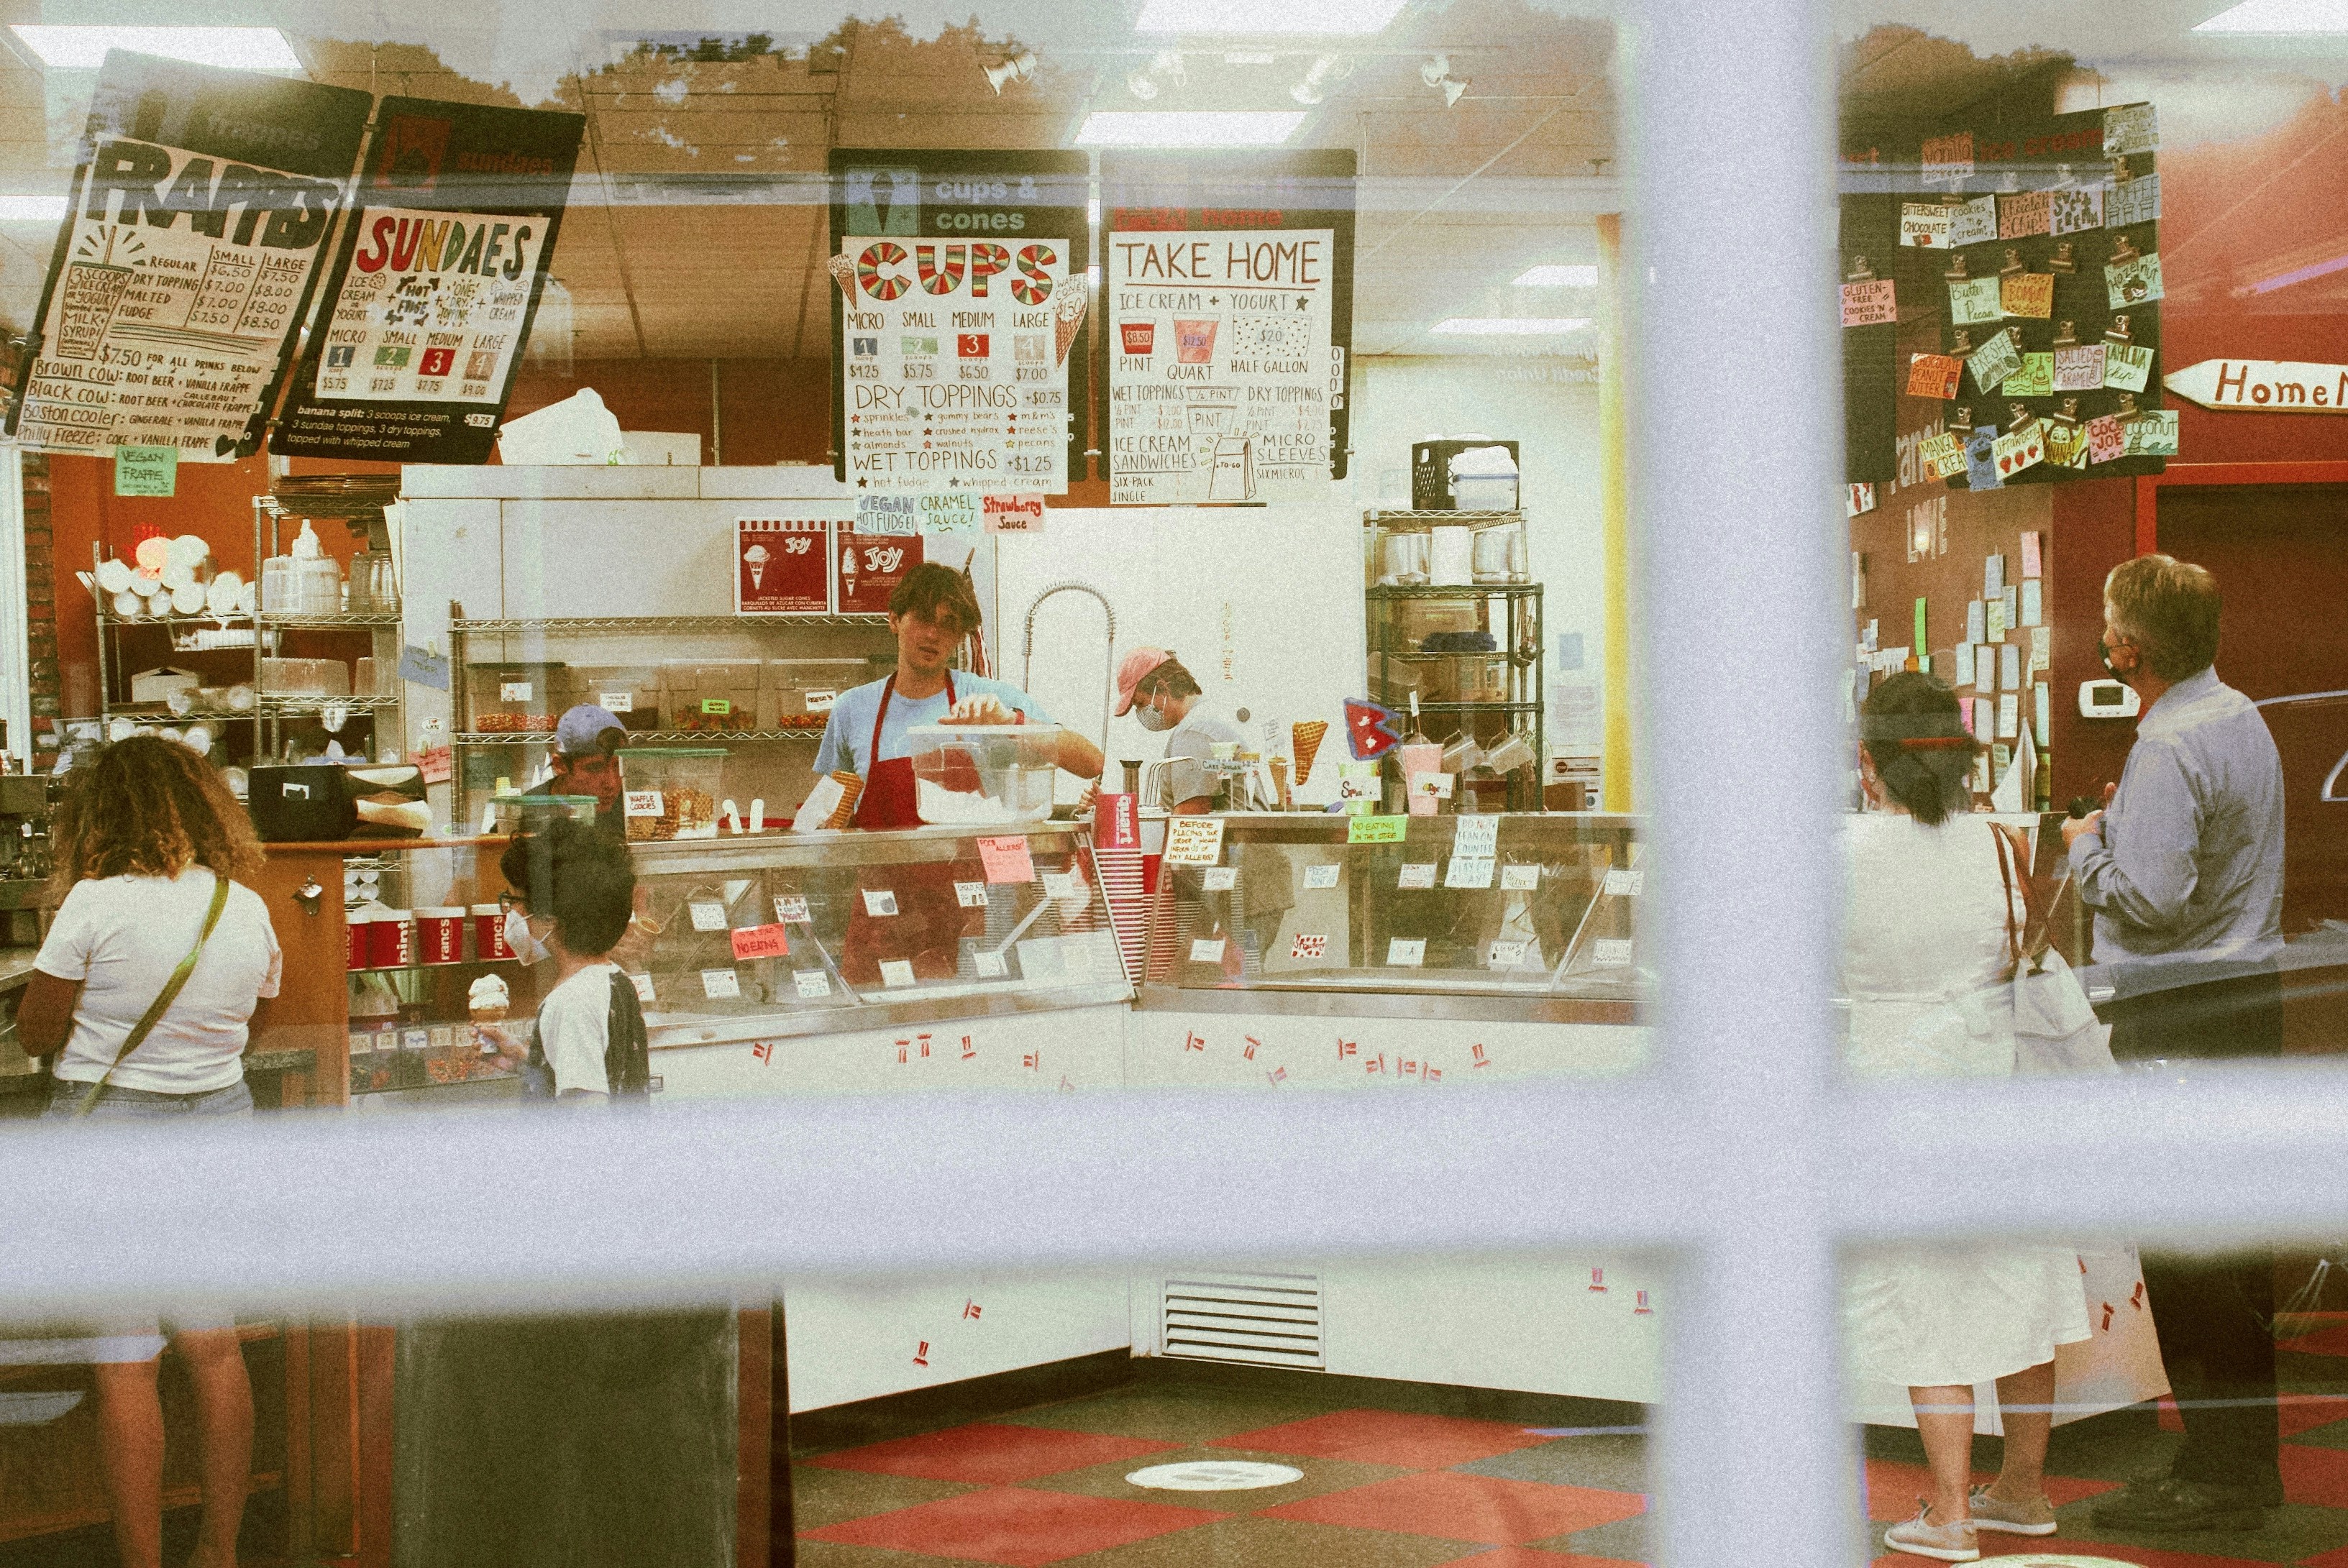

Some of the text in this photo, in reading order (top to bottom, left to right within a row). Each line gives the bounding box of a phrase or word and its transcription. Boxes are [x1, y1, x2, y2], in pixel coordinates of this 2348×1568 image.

[935, 175, 1038, 206] cups &
[1903, 205, 1950, 217] BITTERSWEET
[1952, 204, 1986, 217] cookies
[935, 212, 1025, 231] cones
[1904, 222, 1947, 234] CHOCOLATE
[356, 216, 532, 281] SUNDAES
[213, 250, 307, 270] SMALL LARGE
[1115, 241, 1321, 284] TAKE HOME
[83, 269, 128, 285] SCOOPS
[150, 256, 299, 284] REGULAR $6.50 $7.50
[857, 242, 1057, 306] CUPS
[132, 273, 293, 298] DRY TOPPING $7.00 $8.00
[124, 289, 172, 304] MALTED
[341, 289, 375, 302] CREAM
[1148, 293, 1201, 311] CREAM
[1230, 293, 1291, 312] YOGURT
[196, 295, 287, 314] $7.00 $8.00
[1844, 306, 1875, 315] COOKIES
[118, 305, 155, 320] FUDGE
[1859, 313, 1886, 323] CREAM
[190, 311, 280, 330] $7.50 $8.50
[847, 312, 1050, 329] MICRO SMALL MEDIUM LARGE
[329, 329, 506, 349] MICRO SMALL MEDIUM LARGE
[966, 335, 979, 354] 3
[98, 342, 142, 366] $7.50
[147, 353, 164, 364] FOR
[170, 357, 187, 367] ALL
[195, 359, 225, 371] DRINKS
[230, 364, 262, 374] BELOW
[1974, 337, 2009, 371] FRESH
[35, 359, 83, 378] Brown
[429, 351, 444, 373] 3
[1119, 356, 1308, 381] PINT QUART HALF GALLON
[903, 364, 933, 379] $5.75
[1015, 367, 1047, 380] $7.00
[1911, 368, 1946, 382] PEANUT
[126, 372, 251, 393] ROOT BEER VANILLA FRAPPE
[1909, 381, 1942, 395] BUTTER
[183, 392, 237, 402] CALLEBAUT
[856, 384, 1017, 409] DRY TOPPINGS
[1112, 385, 1184, 401] WET TOPPINGS
[1210, 389, 1233, 400] PINT
[1248, 387, 1323, 402] DRY TOPPINGS
[119, 394, 168, 408] ROOT BEER
[24, 404, 69, 421] Boston
[297, 405, 422, 421] banana split: scoops ice
[863, 413, 909, 423] sprinkles
[938, 411, 999, 425] gummy bears
[1194, 412, 1223, 427] PINT
[184, 417, 246, 430] VANILLA FRAPPE
[301, 421, 334, 431] sundae
[864, 428, 892, 437] heath
[935, 426, 999, 437] crushed hydrox
[106, 434, 211, 449] COKE VANILLA FRAPPE
[287, 434, 411, 449] topped with whipped cream
[864, 441, 906, 449] almonds
[936, 439, 973, 449] walnuts
[1018, 439, 1056, 450] pecans
[1139, 436, 1191, 453] CREAM
[1263, 434, 1315, 446] MICRO
[1921, 434, 1955, 460] MANGO
[2096, 432, 2124, 449] JOE
[122, 450, 165, 463] VEGAN
[854, 449, 997, 471] WET TOPPINGS
[1258, 446, 1326, 462] SLEEVES
[1113, 453, 1197, 471] SANDWICHES
[122, 467, 163, 481] FRAPPE
[1113, 476, 1154, 487] SIX-PACK
[897, 477, 929, 490] fudge
[963, 477, 1051, 490] whipped cream
[859, 495, 915, 513] VEGAN
[921, 495, 975, 512] CARAMEL
[1113, 490, 1146, 503] JINGLE
[982, 496, 1042, 517] Strawberry
[926, 513, 974, 528] sauce!
[997, 515, 1028, 530] Sauce
[1116, 794, 1133, 845] quart
[1179, 820, 1214, 829] BEFORE
[1352, 822, 1394, 831] NO EATING
[1173, 828, 1202, 837] PLACING
[1458, 831, 1479, 841] LEAN
[1456, 843, 1493, 854] COUNTER
[736, 943, 750, 954] NO
